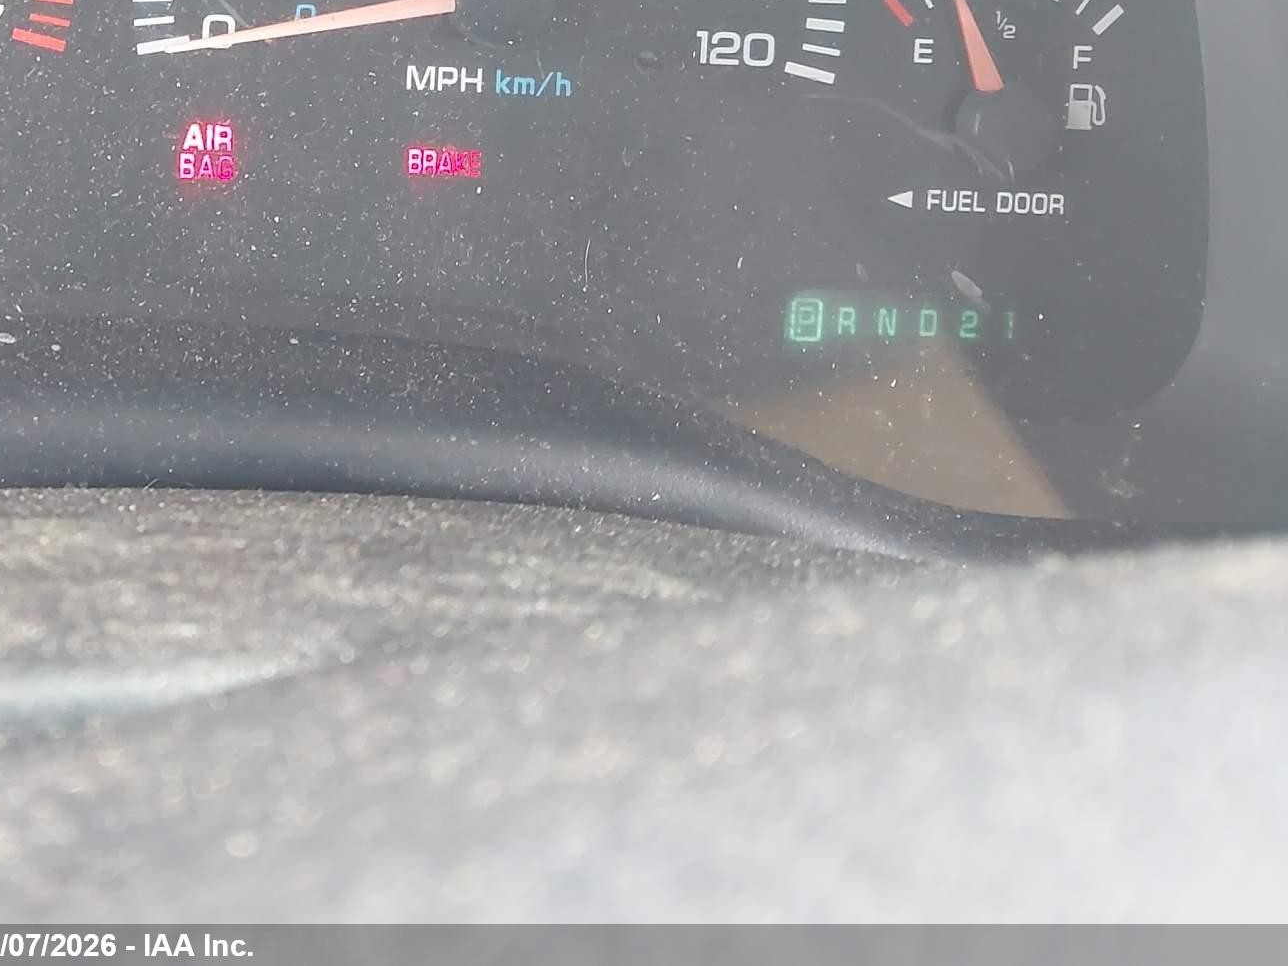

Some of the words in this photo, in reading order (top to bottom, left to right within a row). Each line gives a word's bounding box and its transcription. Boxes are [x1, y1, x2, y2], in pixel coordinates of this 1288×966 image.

[202, 14, 236, 49] 0
[696, 32, 775, 67] 120
[913, 38, 935, 64] E
[1073, 46, 1093, 69] F
[405, 66, 484, 92] MPH
[495, 71, 572, 96] km/h
[182, 124, 233, 151] AIR
[179, 153, 234, 179] BAG
[408, 149, 481, 177] BRAKE
[927, 190, 986, 213] FUEL
[996, 192, 1064, 214] DOOR
[799, 307, 816, 333] P
[838, 307, 856, 335] R
[878, 308, 897, 336] N
[919, 310, 938, 336] D
[960, 311, 979, 338] 2
